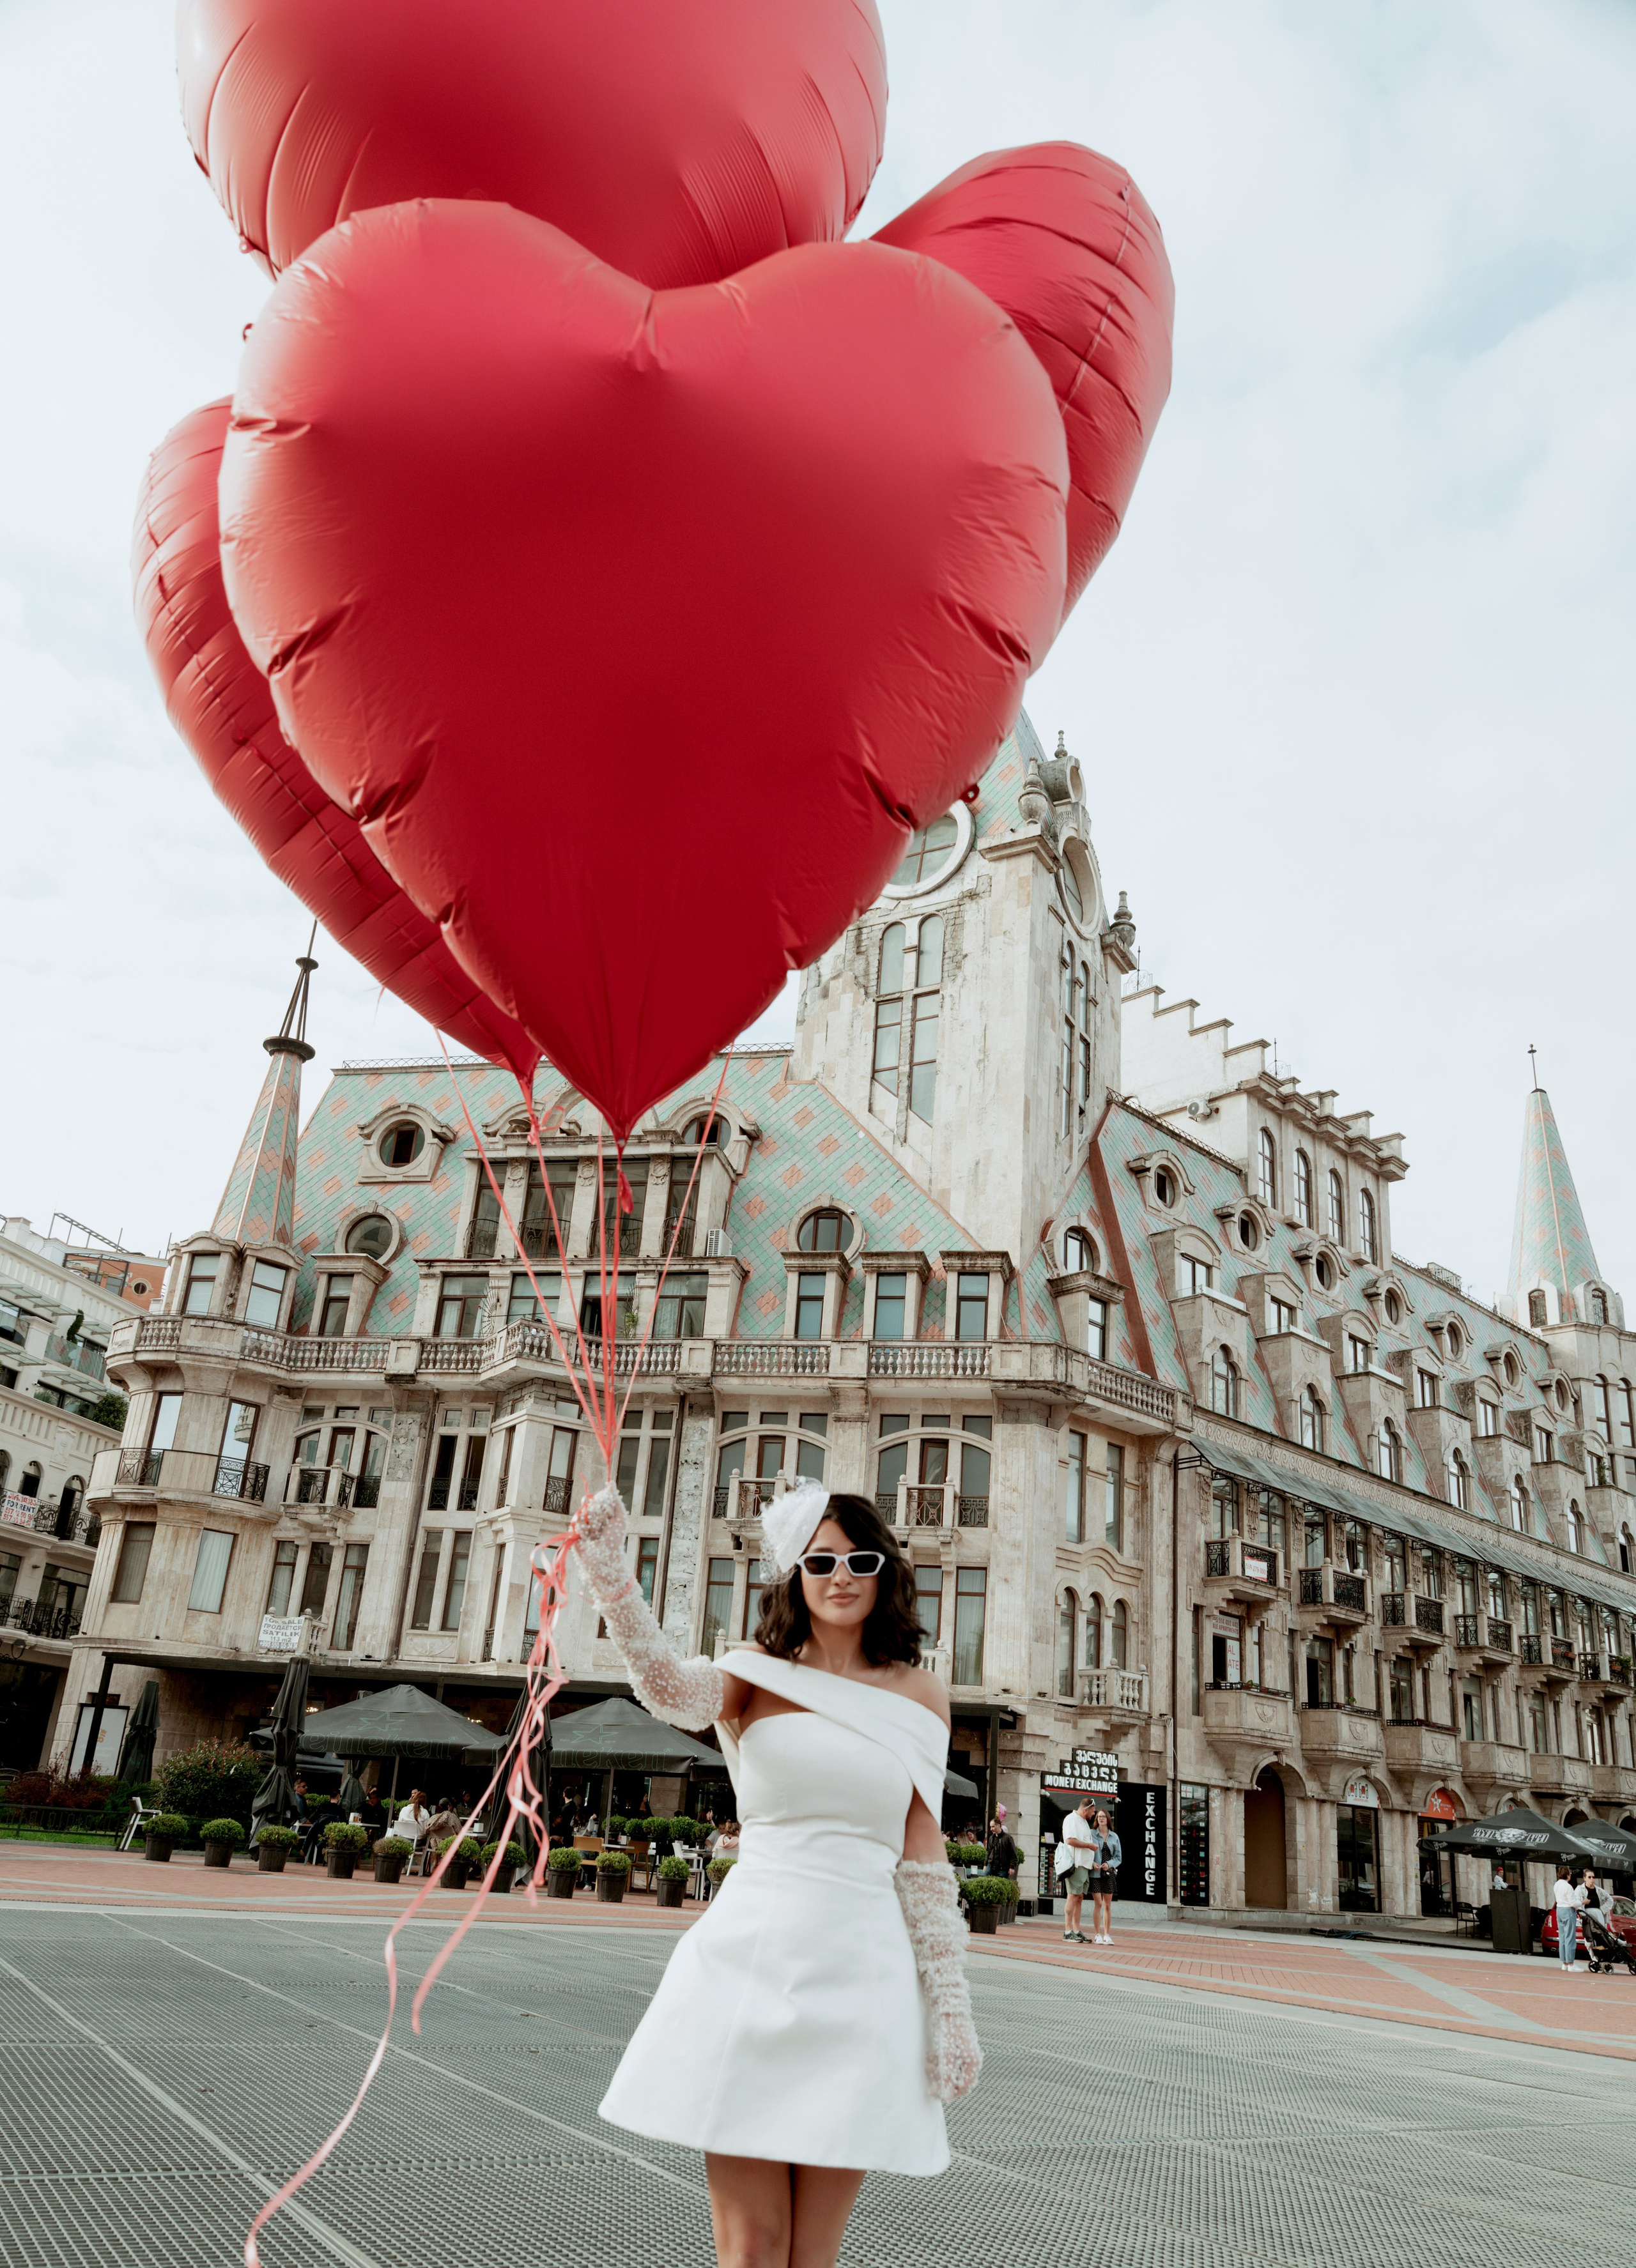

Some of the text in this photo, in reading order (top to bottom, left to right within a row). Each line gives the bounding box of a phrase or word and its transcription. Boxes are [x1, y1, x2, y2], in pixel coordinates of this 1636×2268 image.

[7, 1499, 36, 1513] FOR RENT
[299, 1731, 452, 1759] eineken
[1076, 1750, 1118, 1767] ვალუტის
[1044, 1775, 1118, 1793] MONEY EXCHANGE
[1145, 1792, 1156, 1896] EXCHANGE
